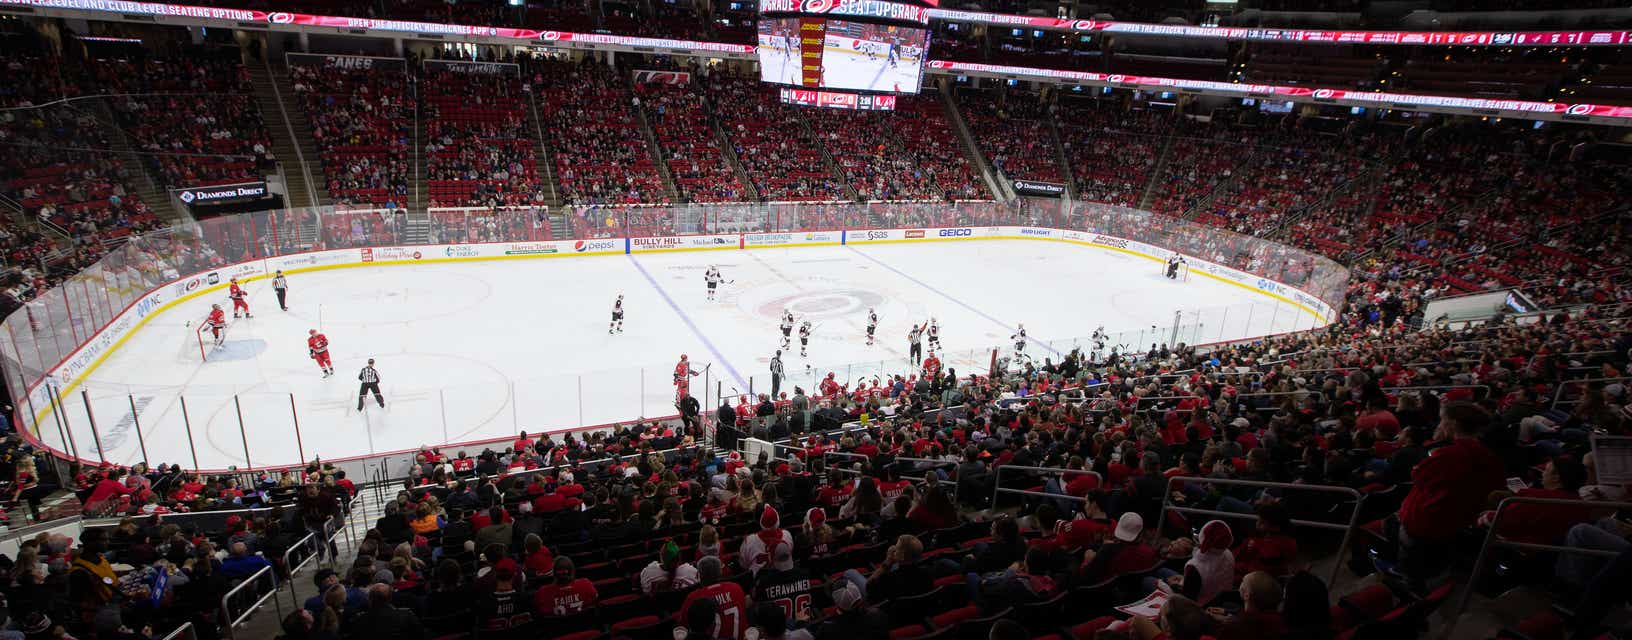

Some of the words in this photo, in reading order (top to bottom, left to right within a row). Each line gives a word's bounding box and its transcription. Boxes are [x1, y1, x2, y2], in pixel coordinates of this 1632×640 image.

[168, 5, 211, 17] SEATING
[212, 8, 254, 20] OPTIONS
[840, 0, 871, 15] SEAT
[876, 4, 919, 21] UPGRADE
[472, 26, 487, 35] APP
[325, 56, 373, 69] CANES
[196, 190, 237, 200] DIAMONDS
[238, 187, 264, 197] DIRECT
[939, 229, 971, 237] GEICO
[588, 240, 614, 252] pepsi
